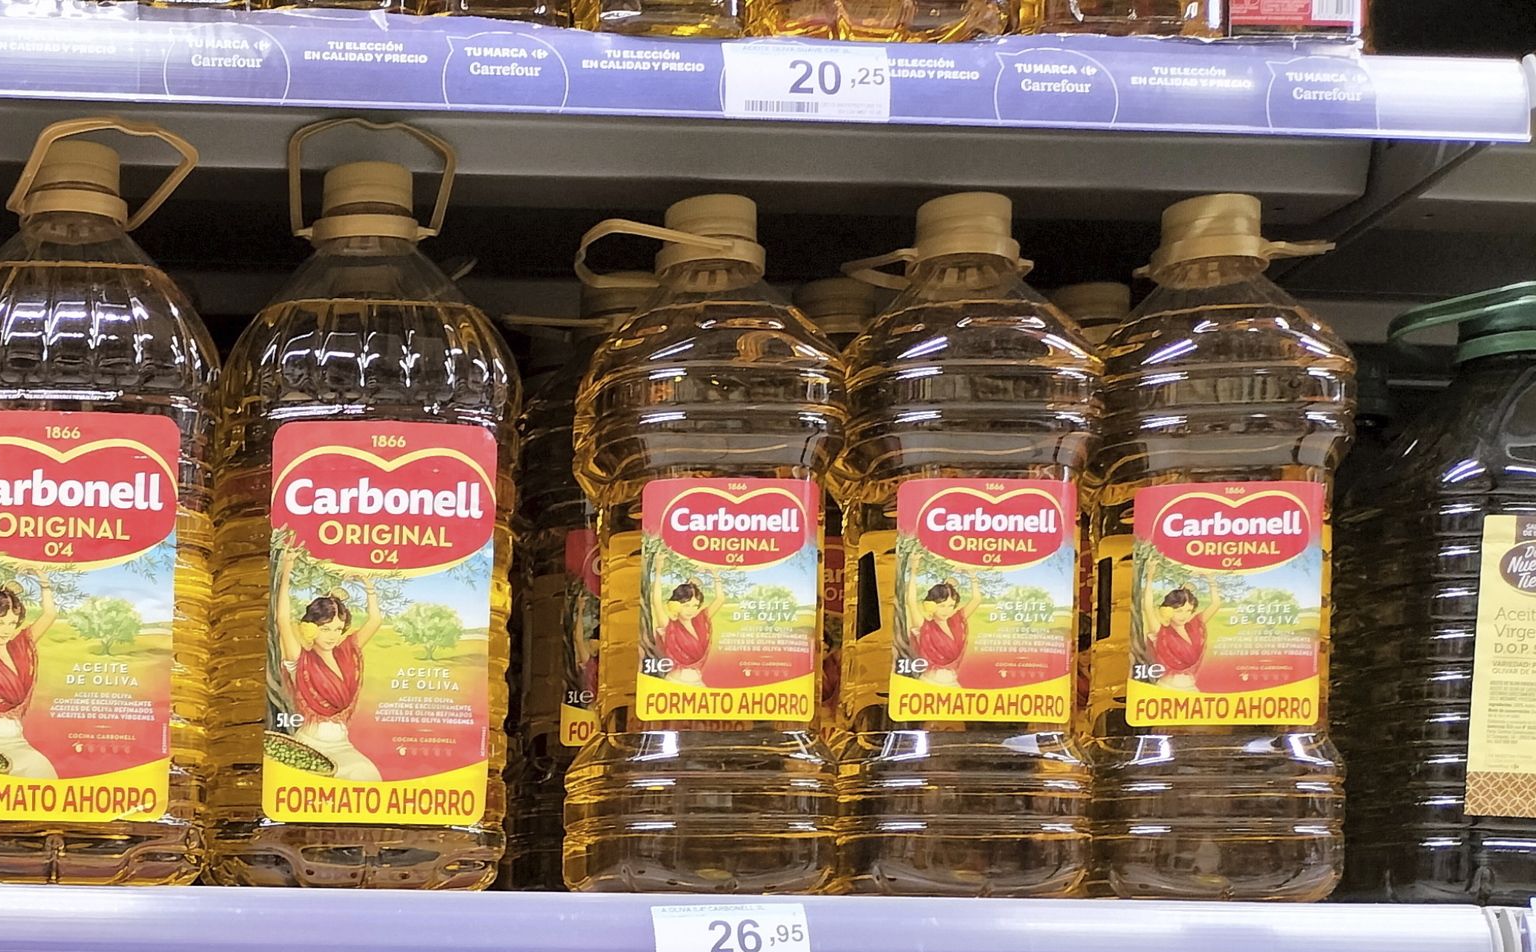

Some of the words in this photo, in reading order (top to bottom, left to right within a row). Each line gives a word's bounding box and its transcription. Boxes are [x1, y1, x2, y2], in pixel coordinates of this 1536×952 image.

[327, 41, 344, 52] TU
[345, 41, 404, 54] ELECCIÓN
[464, 47, 482, 58] TU
[483, 48, 528, 59] MARCA
[605, 49, 621, 60] TU
[622, 50, 681, 61] ELECCIÓN
[190, 53, 264, 69] Carrefour
[304, 51, 321, 62] EN
[322, 52, 372, 64] CALIDAD
[373, 52, 383, 64] Y
[384, 53, 428, 65] PRECIO
[469, 62, 542, 77] Carrefour
[582, 60, 598, 71] EN
[599, 60, 650, 72] CALIDAD
[651, 61, 661, 72] Y
[662, 61, 705, 73] PRECIO
[1014, 63, 1032, 74] TU
[1033, 64, 1078, 75] MARCA
[1020, 79, 1092, 93] Carrefour
[1292, 87, 1362, 102] Carrefour
[44, 426, 81, 439] 1866
[370, 435, 406, 448] 1866
[284, 477, 484, 519] Carbonell
[1224, 487, 1245, 495] 1866
[670, 507, 799, 533] Carbonell
[927, 507, 1056, 534] Carbonell
[1162, 510, 1302, 537] Carbonell
[317, 520, 452, 547] ORIGINAL
[691, 536, 779, 553] ORIGINAL
[949, 536, 1037, 553] ORIGINAL
[1186, 540, 1281, 556] ORIGINAL
[1494, 623, 1536, 642] Virge
[646, 693, 731, 715] FORMATO
[737, 694, 808, 715] AHORRO
[899, 694, 983, 716] FORMATO
[989, 695, 1065, 717] AHORRO
[1135, 697, 1230, 721] FORMATO
[1234, 697, 1312, 720] AHORRO
[62, 785, 156, 814] AHORRO
[275, 786, 378, 814] FORMATO
[385, 788, 475, 816] AHORRO
